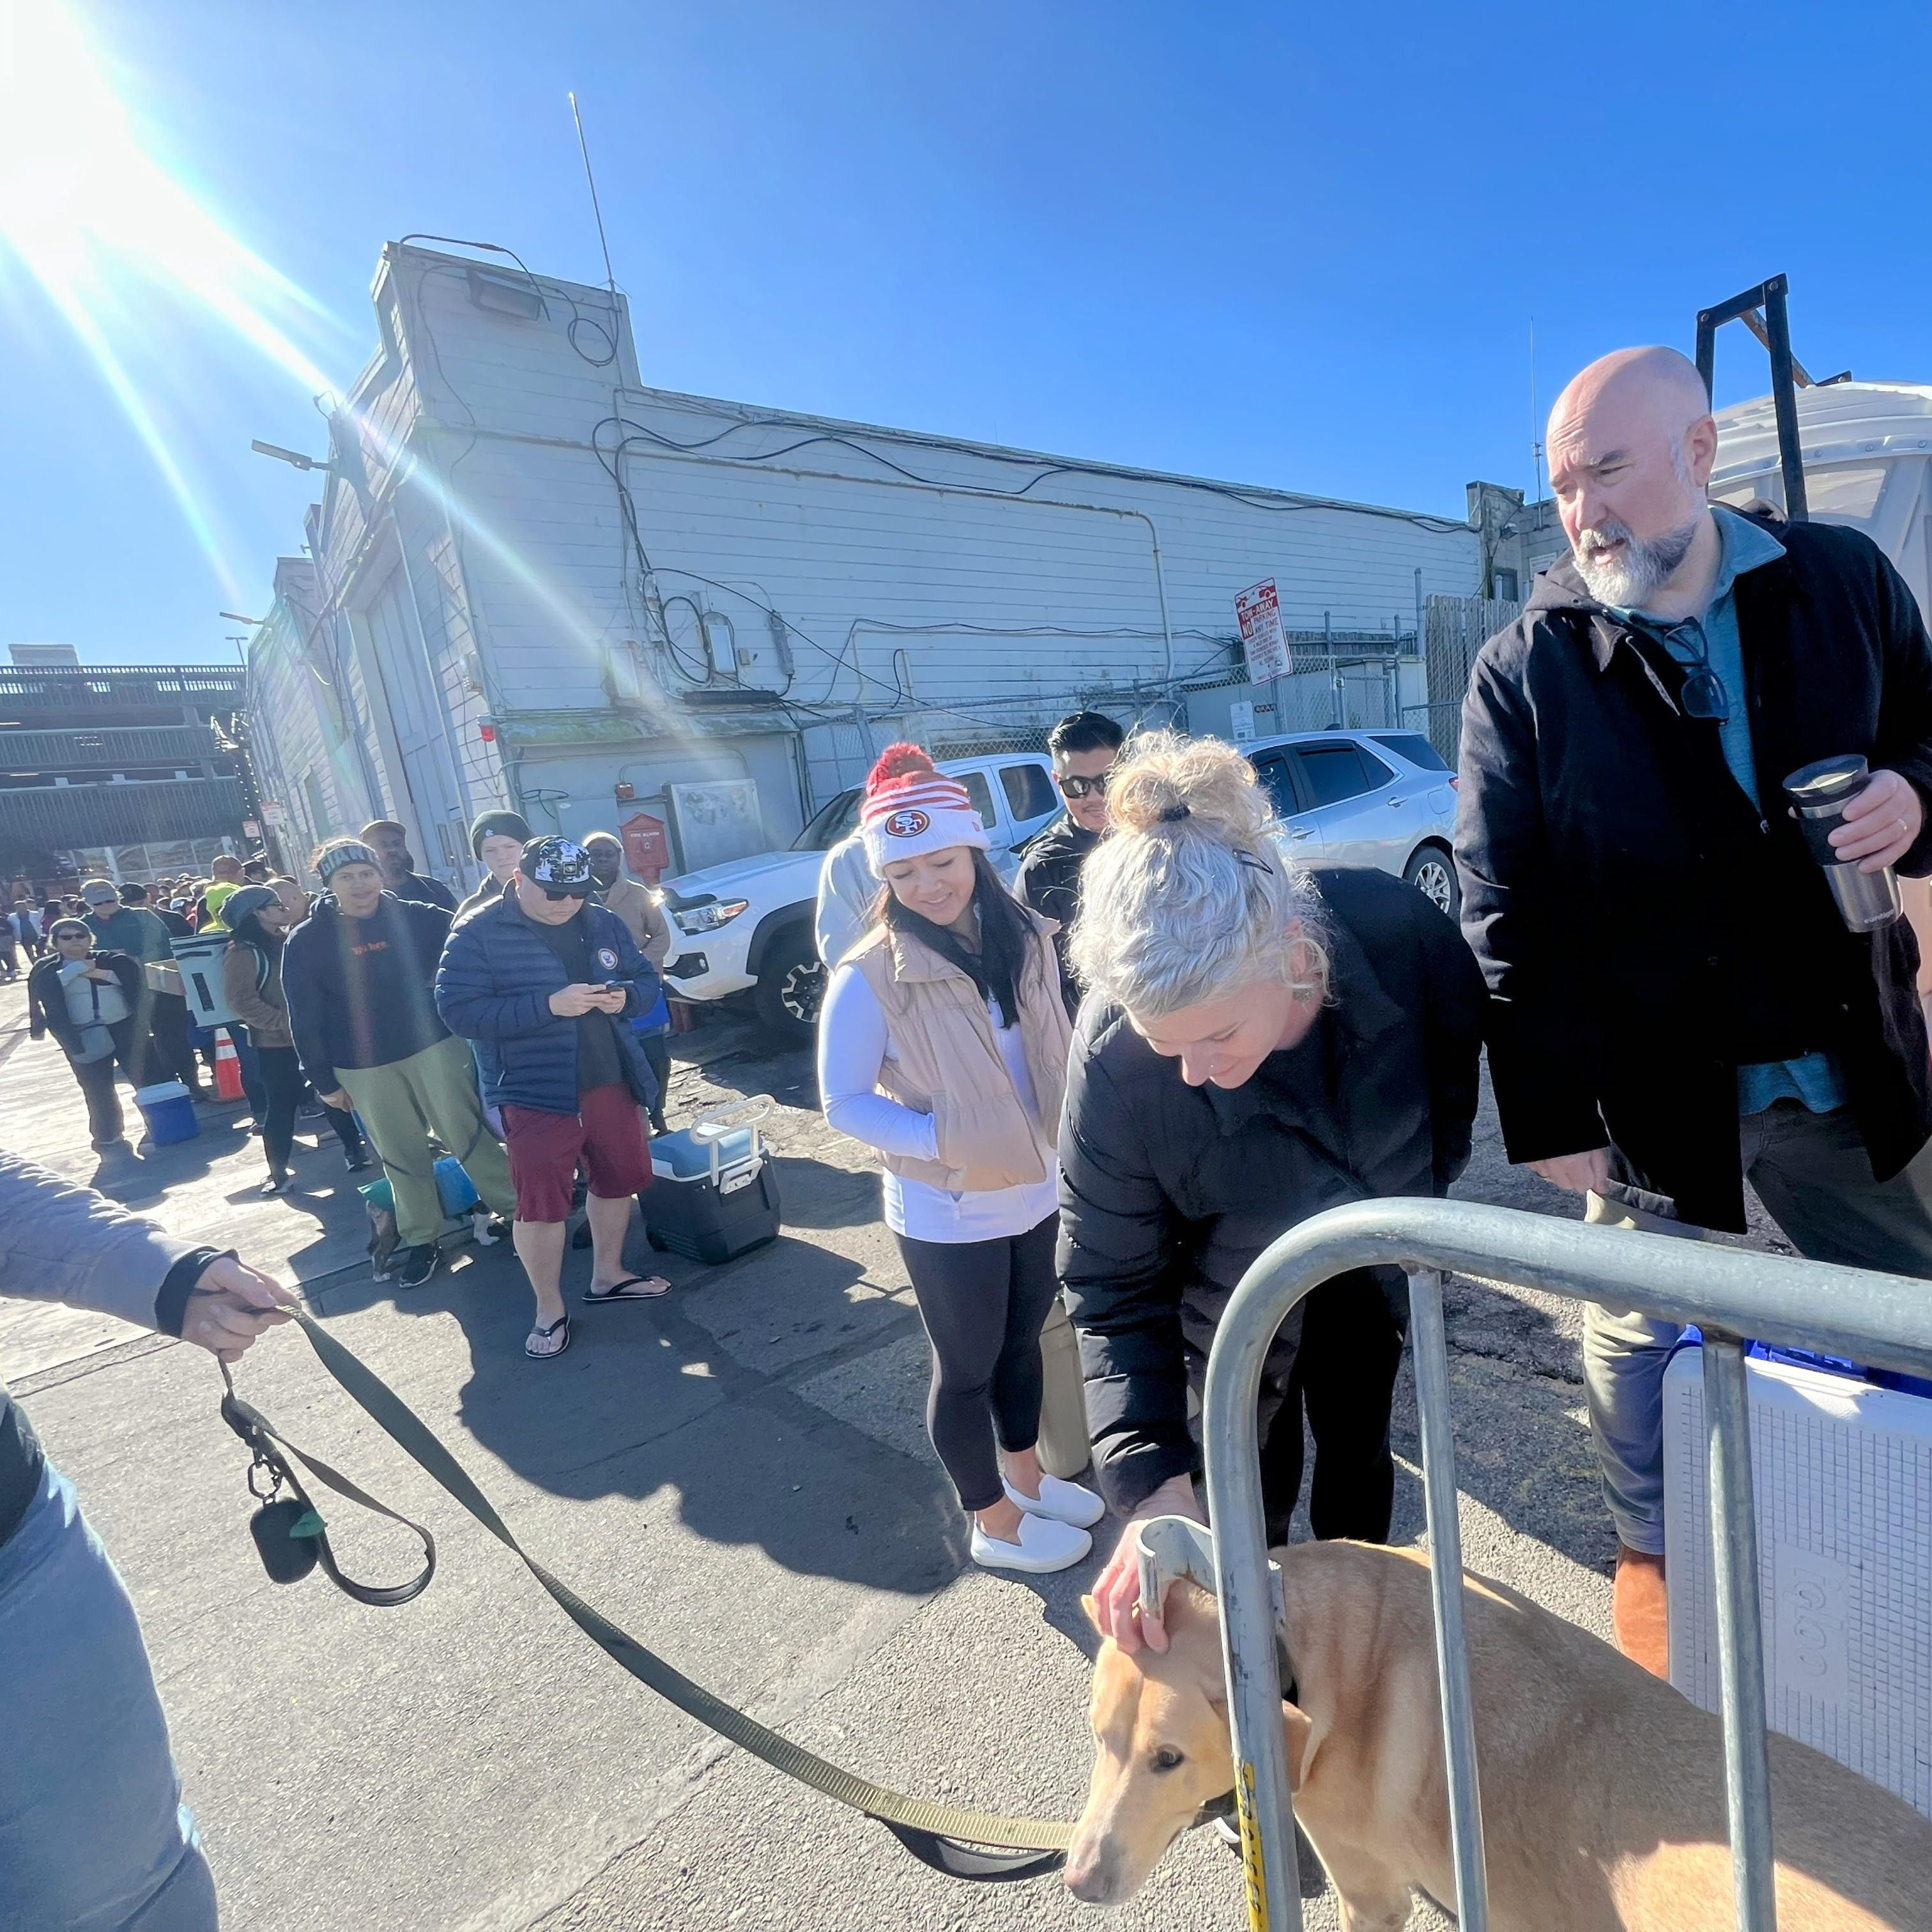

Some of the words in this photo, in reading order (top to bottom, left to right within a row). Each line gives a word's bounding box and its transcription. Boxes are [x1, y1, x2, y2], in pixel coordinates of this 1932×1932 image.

[1241, 598, 1273, 621] TOW-AWAY
[1254, 609, 1276, 624] PARKING
[1242, 621, 1253, 638] NO
[1265, 617, 1279, 629] TIME
